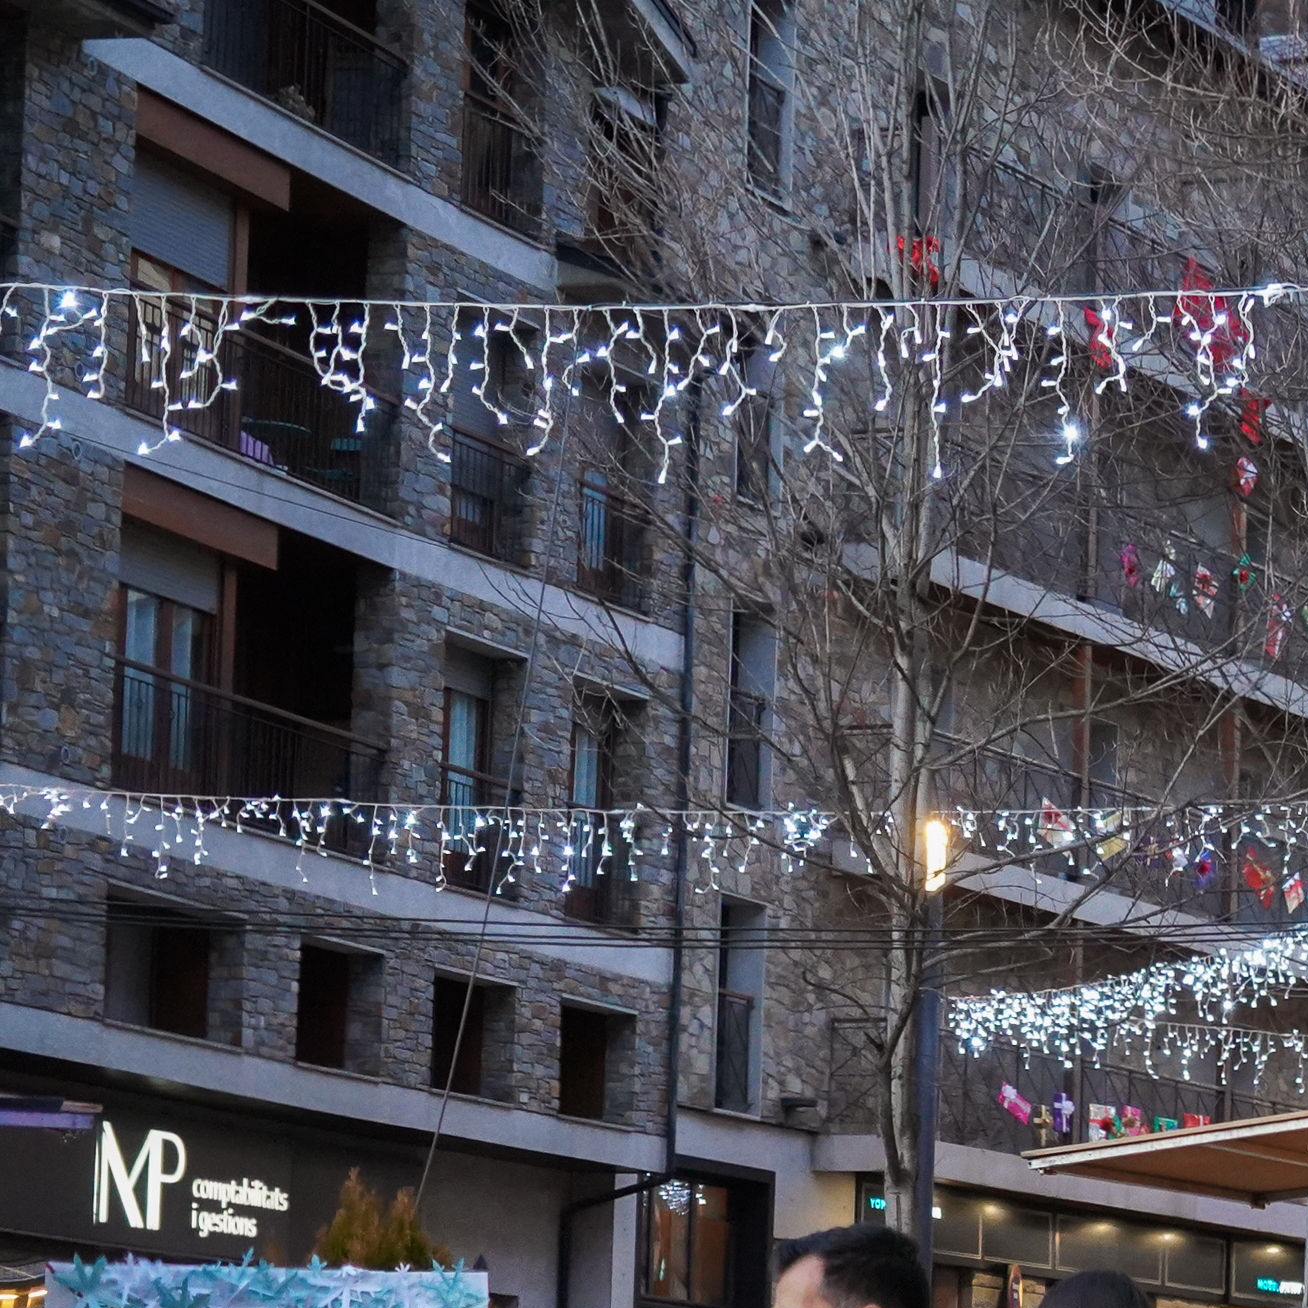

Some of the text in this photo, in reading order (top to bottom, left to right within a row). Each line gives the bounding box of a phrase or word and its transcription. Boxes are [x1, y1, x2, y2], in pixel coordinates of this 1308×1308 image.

[192, 1177, 290, 1212] comptabilitats
[191, 1202, 258, 1238] i gestions
